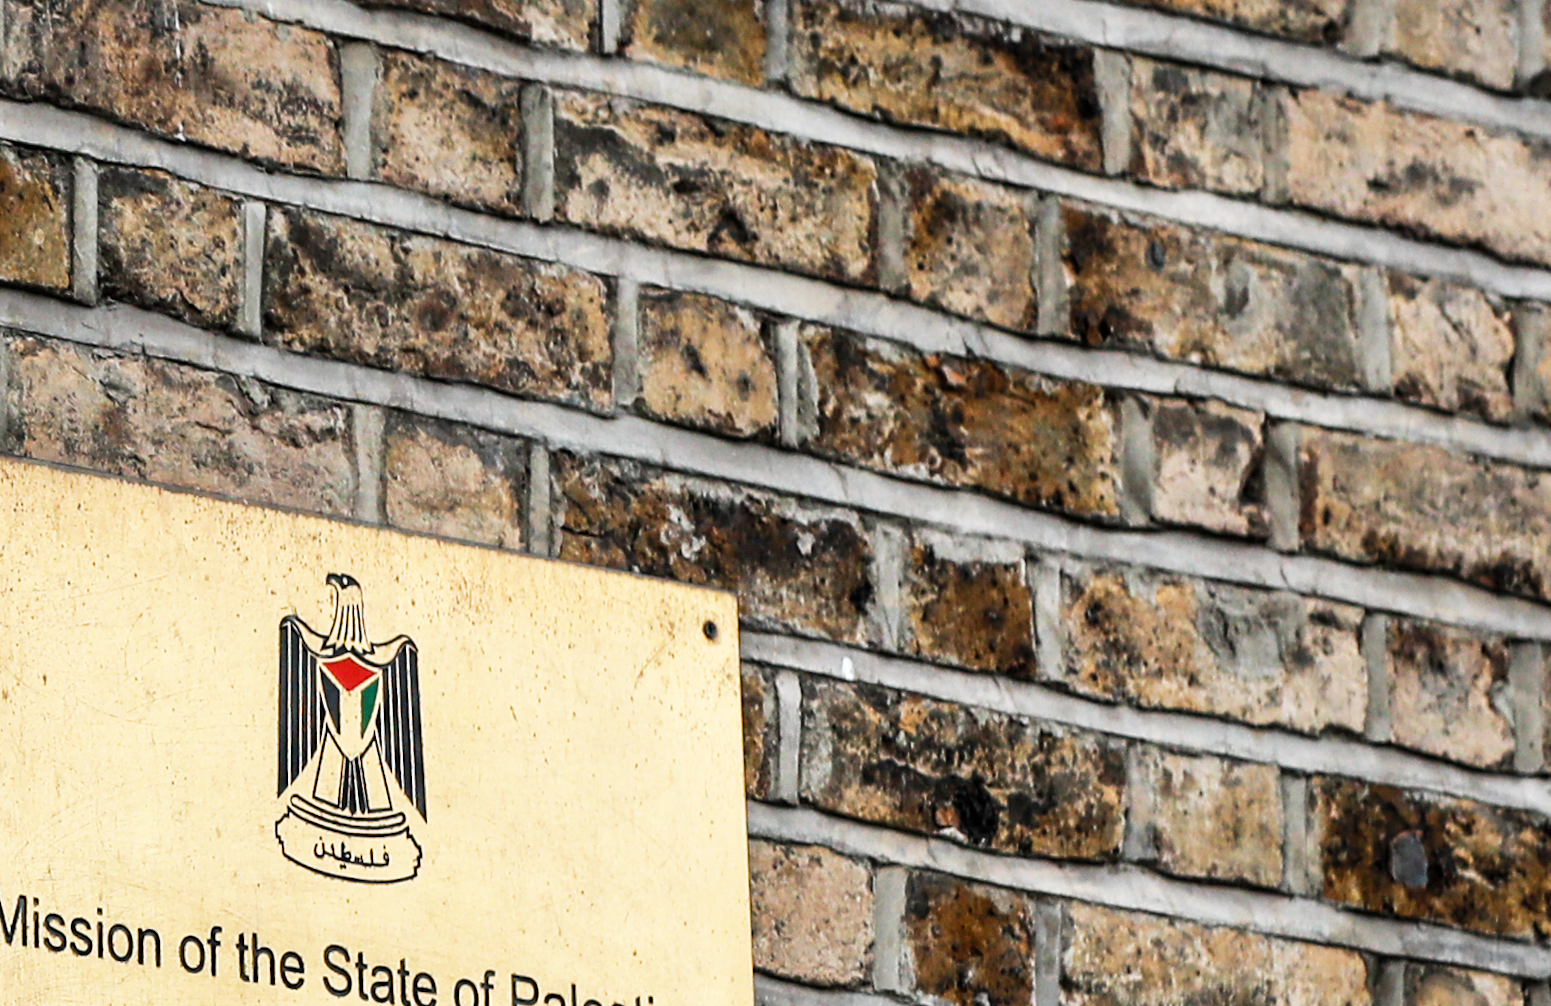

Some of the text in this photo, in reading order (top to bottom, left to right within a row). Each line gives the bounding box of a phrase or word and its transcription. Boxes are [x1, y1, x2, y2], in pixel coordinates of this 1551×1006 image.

[314, 836, 390, 870] فلسطين
[179, 925, 223, 977] of
[235, 932, 305, 991] the
